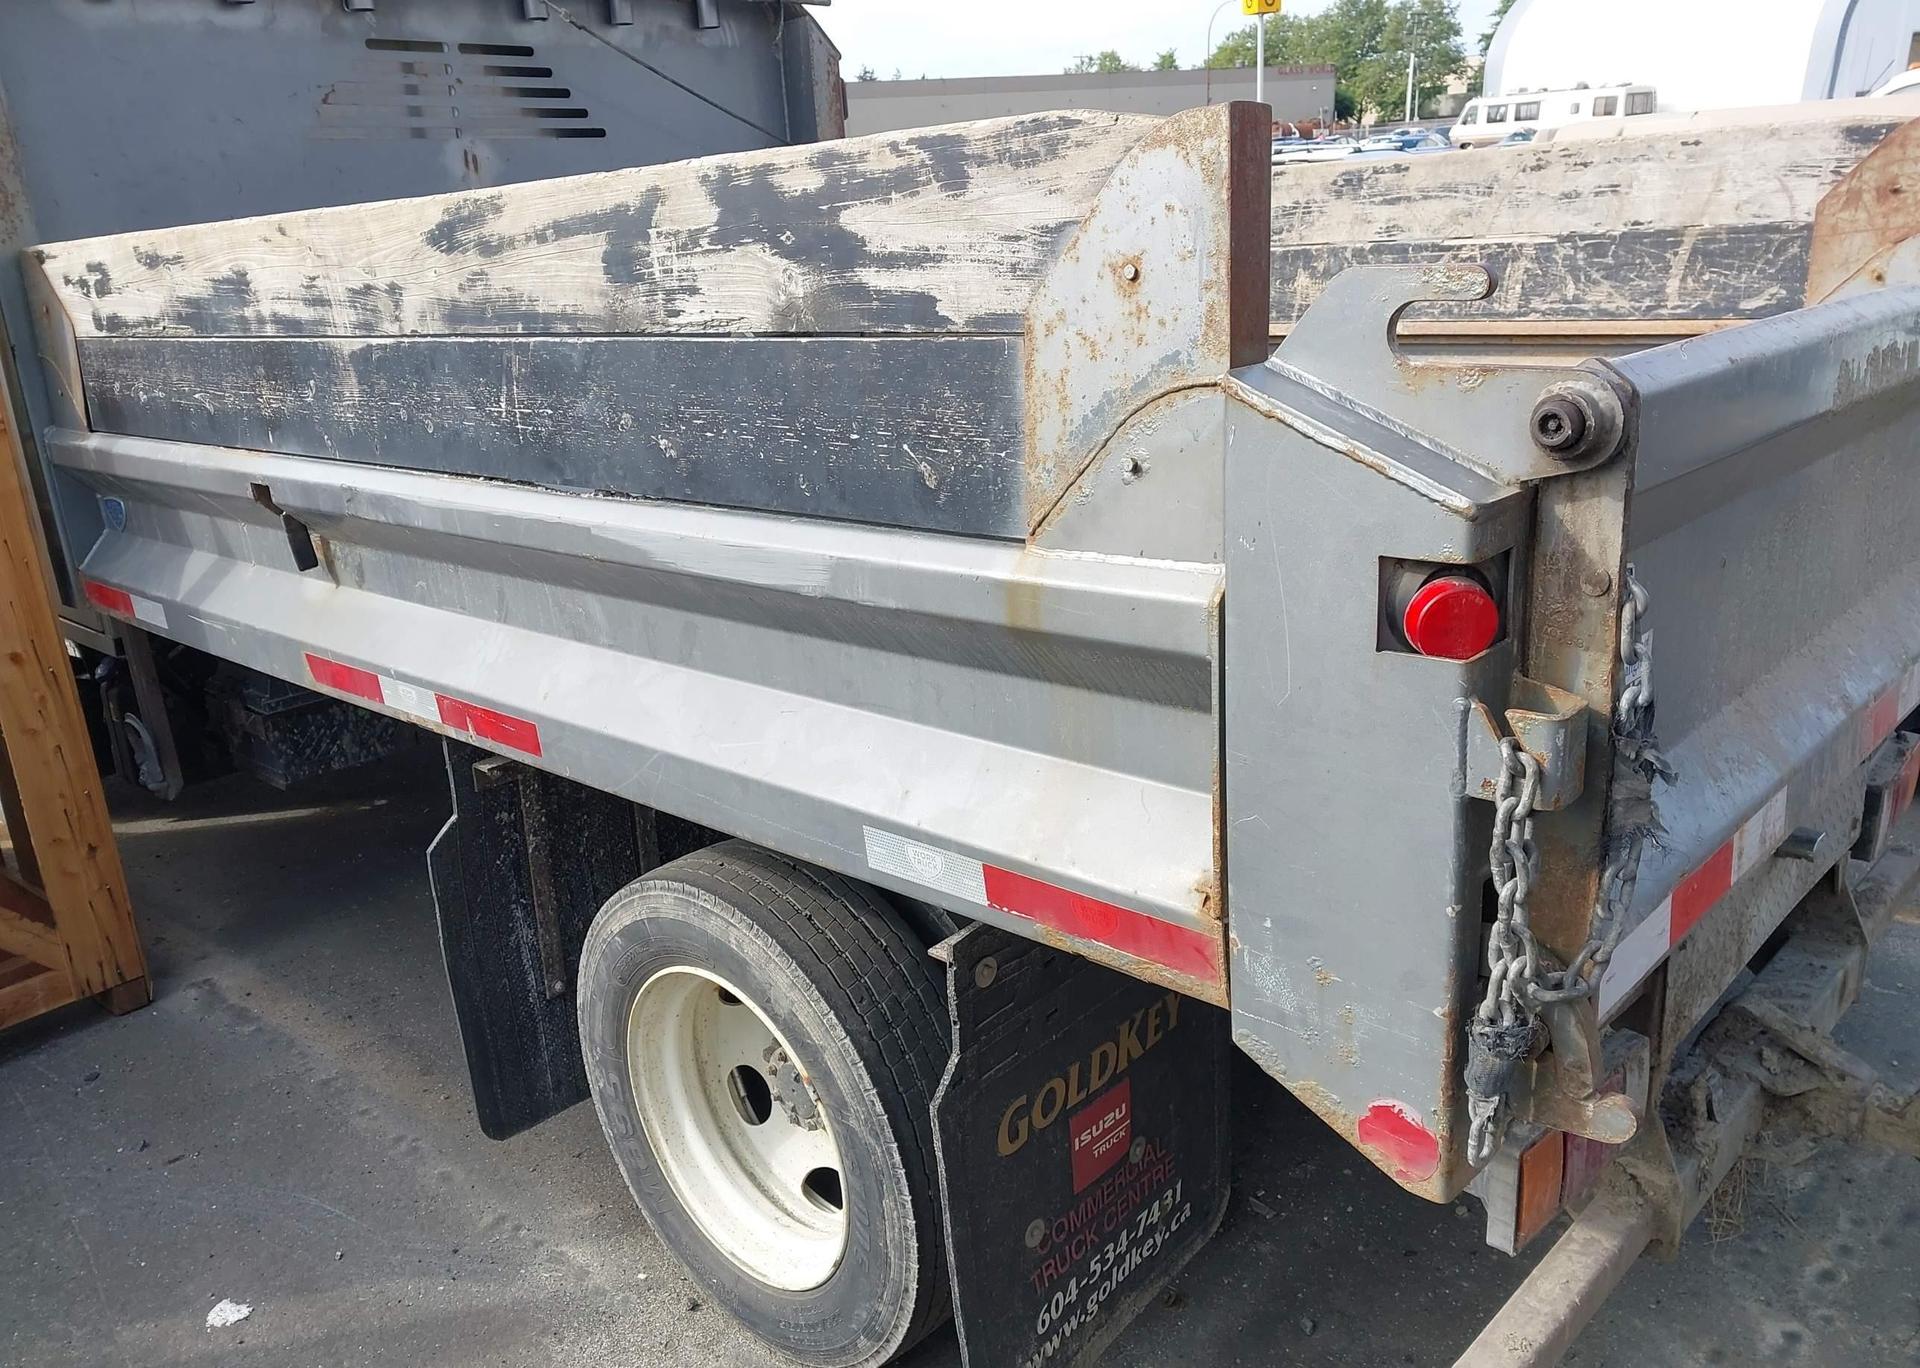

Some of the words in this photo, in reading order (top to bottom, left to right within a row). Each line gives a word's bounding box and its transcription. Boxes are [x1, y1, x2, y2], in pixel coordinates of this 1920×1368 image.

[912, 849, 937, 863] WORK
[913, 856, 939, 871] TRUCK
[997, 990, 1181, 1157] GOLDKEY
[1074, 1103, 1126, 1151] ISUZU
[1093, 1127, 1126, 1159] TRUCK
[1031, 1223, 1100, 1297] TRUCK
[1103, 1152, 1177, 1232] CENTRE
[1036, 1178, 1184, 1336] 604-534-7431
